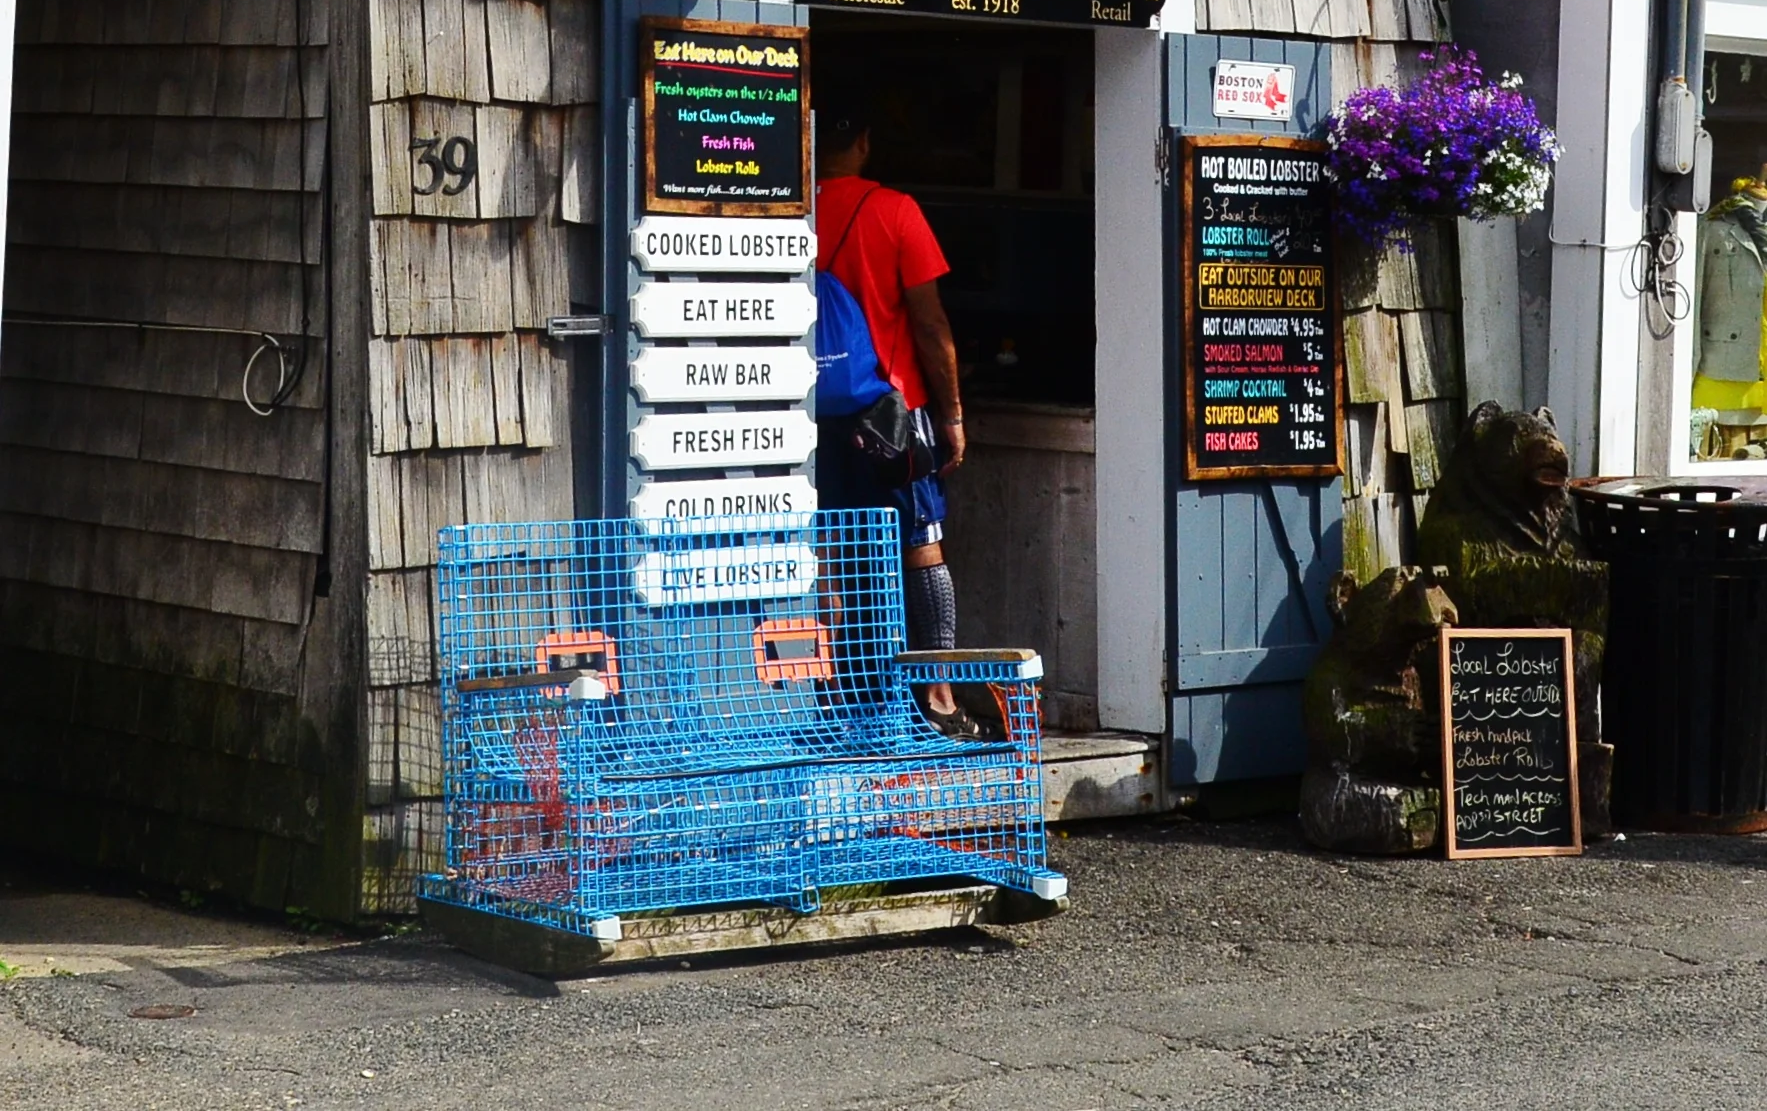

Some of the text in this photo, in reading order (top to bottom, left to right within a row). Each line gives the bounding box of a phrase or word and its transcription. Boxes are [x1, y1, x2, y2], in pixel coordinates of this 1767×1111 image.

[1091, 0, 1131, 21] Retail
[654, 40, 799, 68] Eat Here on Our Deck
[654, 81, 798, 102] Fresh oysters on the 1/2 shell
[1218, 75, 1263, 89] BOSTON
[1218, 89, 1263, 103] RED SOX
[678, 108, 775, 126] Hot Clam Chowder
[702, 136, 754, 151] Fresh Fish
[408, 136, 477, 196] 39
[696, 159, 760, 176] Lobster Rolls
[1201, 156, 1225, 179] HOT
[1227, 157, 1268, 181] BOILED
[1270, 159, 1320, 183] LOBSTER
[646, 232, 809, 257] COOKED LOBSTER
[1202, 225, 1270, 246] LOBSTER ROLL
[1202, 267, 1322, 287] EAT OUTSIDE ON OUR
[1208, 287, 1316, 307] HARBORVIEW DECK
[683, 299, 775, 321] EAT HERE
[1203, 317, 1221, 336] HOT
[1223, 317, 1246, 336] CLAM
[1248, 318, 1288, 336] CHOWDER
[1290, 317, 1315, 337] $4.95
[1204, 344, 1242, 361] SMOKED
[1245, 344, 1283, 362] SALMON
[1303, 342, 1313, 361] $5
[686, 363, 771, 386] RAW BAR
[1204, 379, 1240, 398] SHRIMP
[1242, 379, 1287, 398] COCKTAIL
[1303, 378, 1313, 398] $4
[1205, 406, 1245, 425] STUFFED
[1247, 406, 1279, 424] CLAMS
[1289, 403, 1315, 423] $1.95
[673, 427, 784, 453] FRESH FISH
[1205, 432, 1226, 451] FISH
[1229, 432, 1259, 450] CAKES
[1289, 430, 1315, 450] $1.95
[666, 493, 793, 520] COLD DRINKS
[662, 560, 797, 590] LIVE LOBSTER
[1496, 641, 1560, 676] Lobster
[1451, 682, 1481, 706] EAT
[1485, 686, 1522, 705] HERE
[1456, 745, 1510, 769] Lobster
[1493, 807, 1546, 825] STREET
